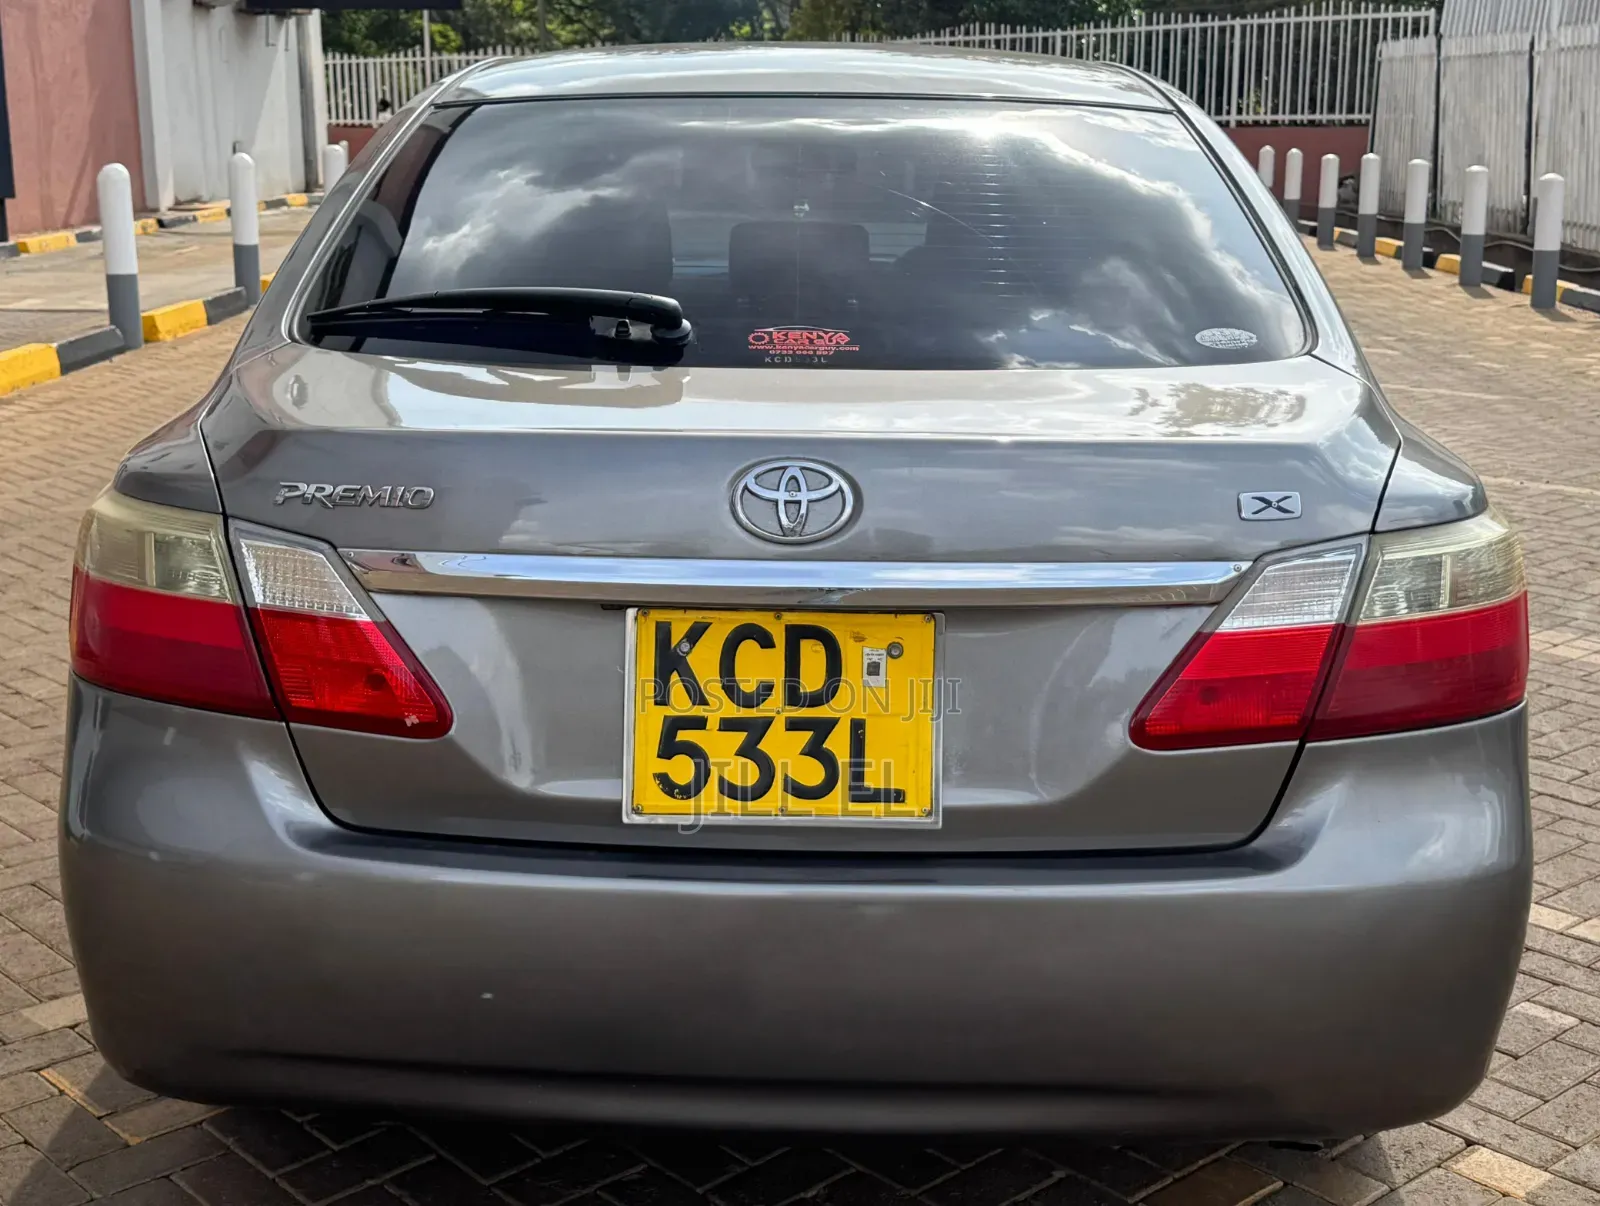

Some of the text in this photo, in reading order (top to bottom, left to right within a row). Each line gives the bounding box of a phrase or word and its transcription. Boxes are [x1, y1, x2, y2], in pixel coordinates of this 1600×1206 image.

[772, 331, 850, 342] KENYA
[273, 481, 435, 509] PREMIO
[654, 621, 842, 708] KCD
[652, 715, 906, 803] 533L
